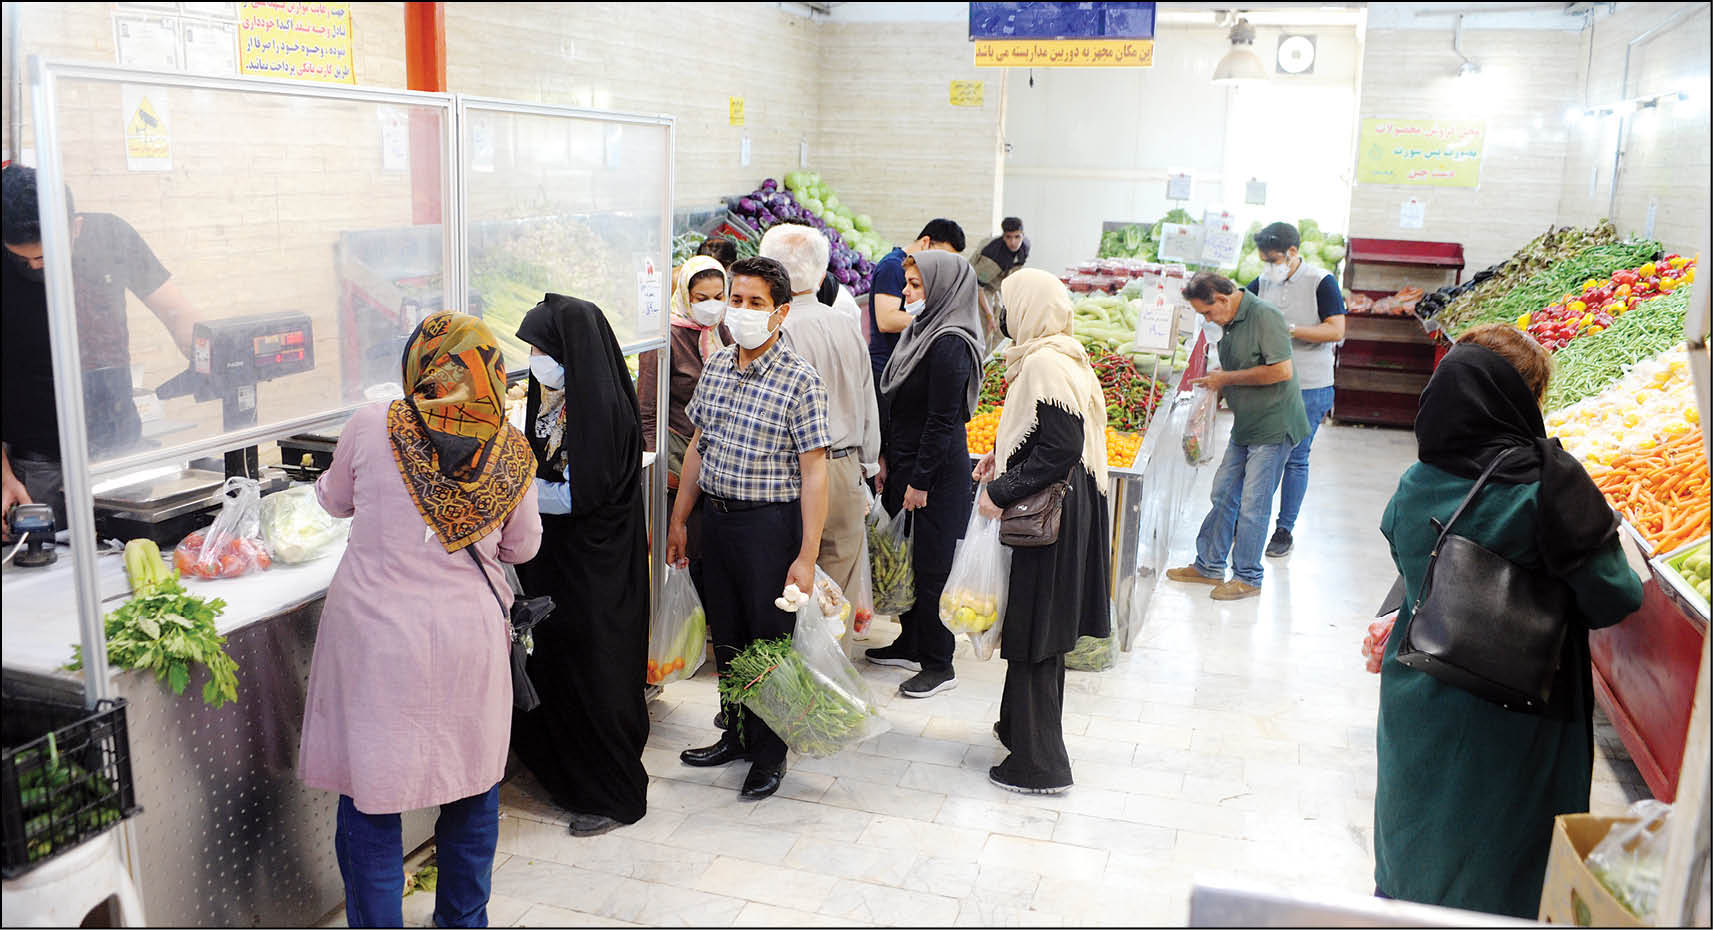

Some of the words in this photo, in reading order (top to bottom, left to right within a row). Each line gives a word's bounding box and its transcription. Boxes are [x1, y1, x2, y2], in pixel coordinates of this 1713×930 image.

[242, 16, 275, 32] خودداری
[254, 37, 272, 53] صرفا
[272, 39, 280, 54] را
[280, 41, 300, 55] خود
[975, 45, 994, 60] باشد
[1115, 43, 1137, 61] مکان
[1139, 43, 1154, 61] این
[996, 49, 1009, 61] می
[1050, 47, 1079, 62] دوربین
[1082, 47, 1090, 61] به
[1092, 46, 1113, 62] مجهز
[270, 60, 296, 76] پرداخت
[297, 63, 315, 76] بانکی
[316, 64, 332, 77] کارت
